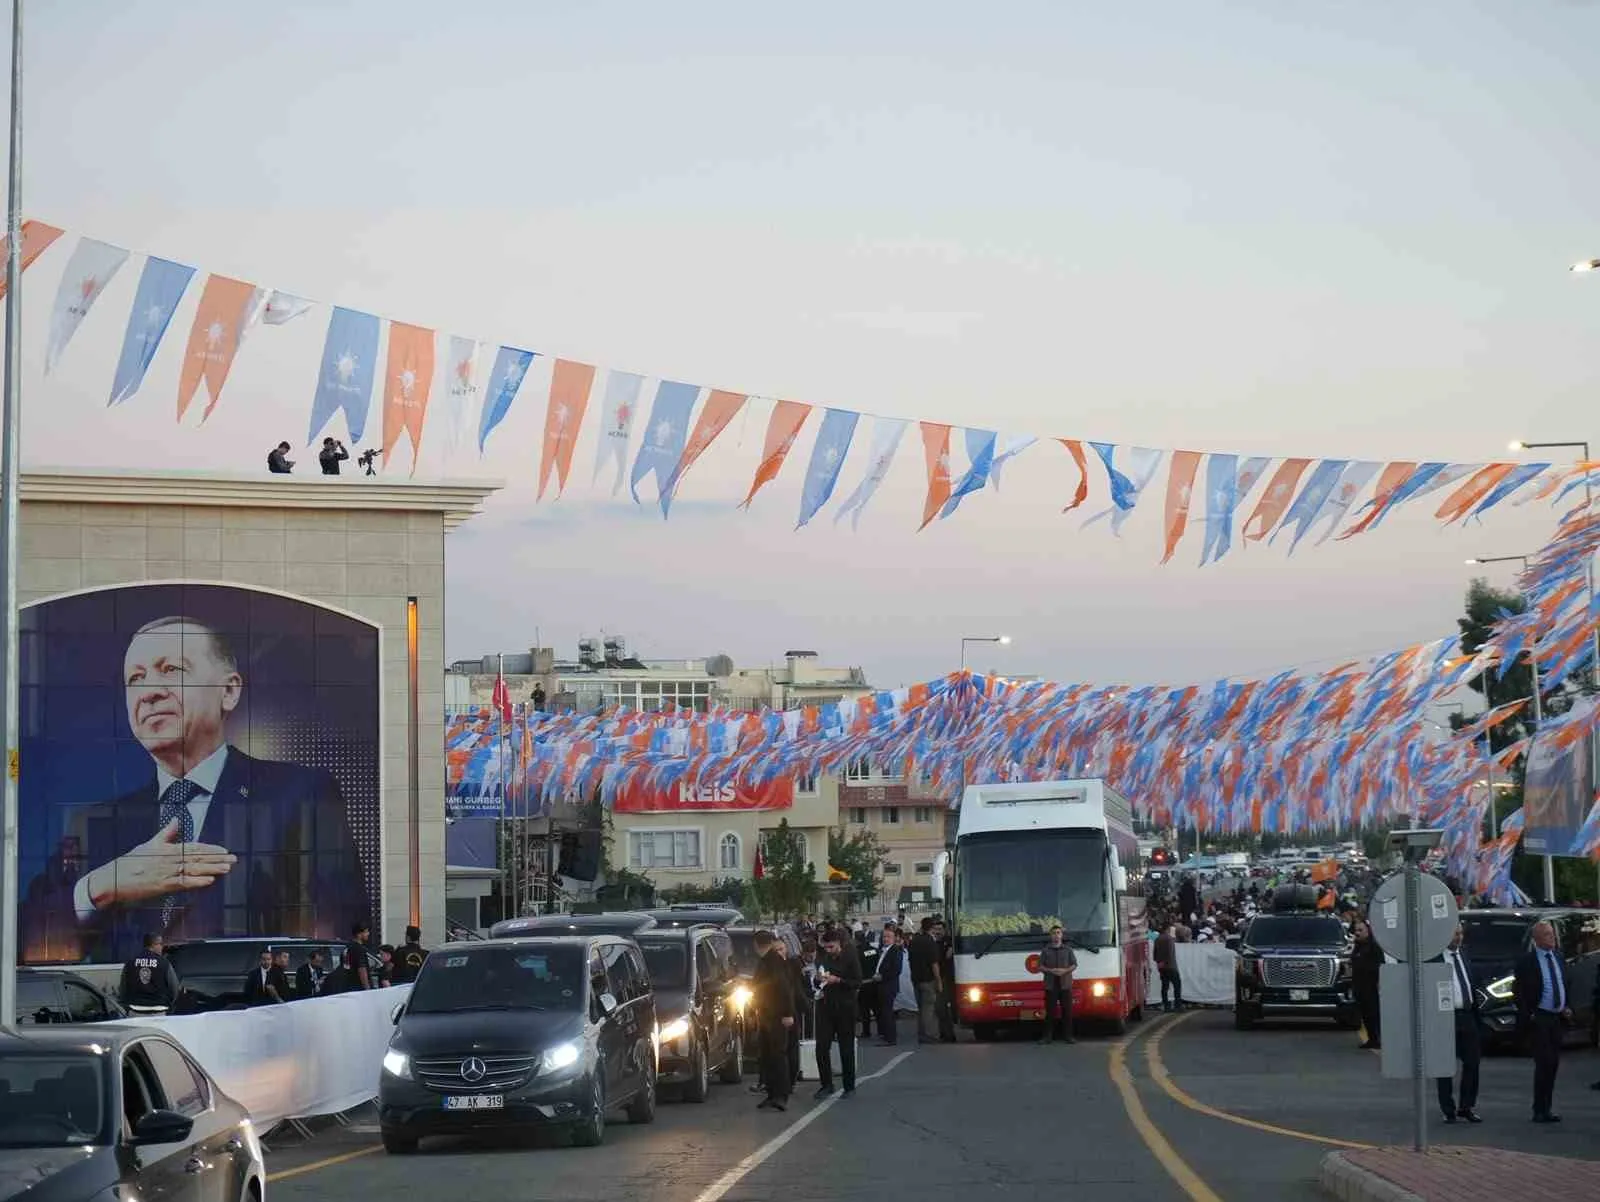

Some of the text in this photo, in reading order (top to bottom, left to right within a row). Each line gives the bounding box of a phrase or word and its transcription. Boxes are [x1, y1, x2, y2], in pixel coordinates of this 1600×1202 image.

[448, 1095, 502, 1108] 47 AK 319
